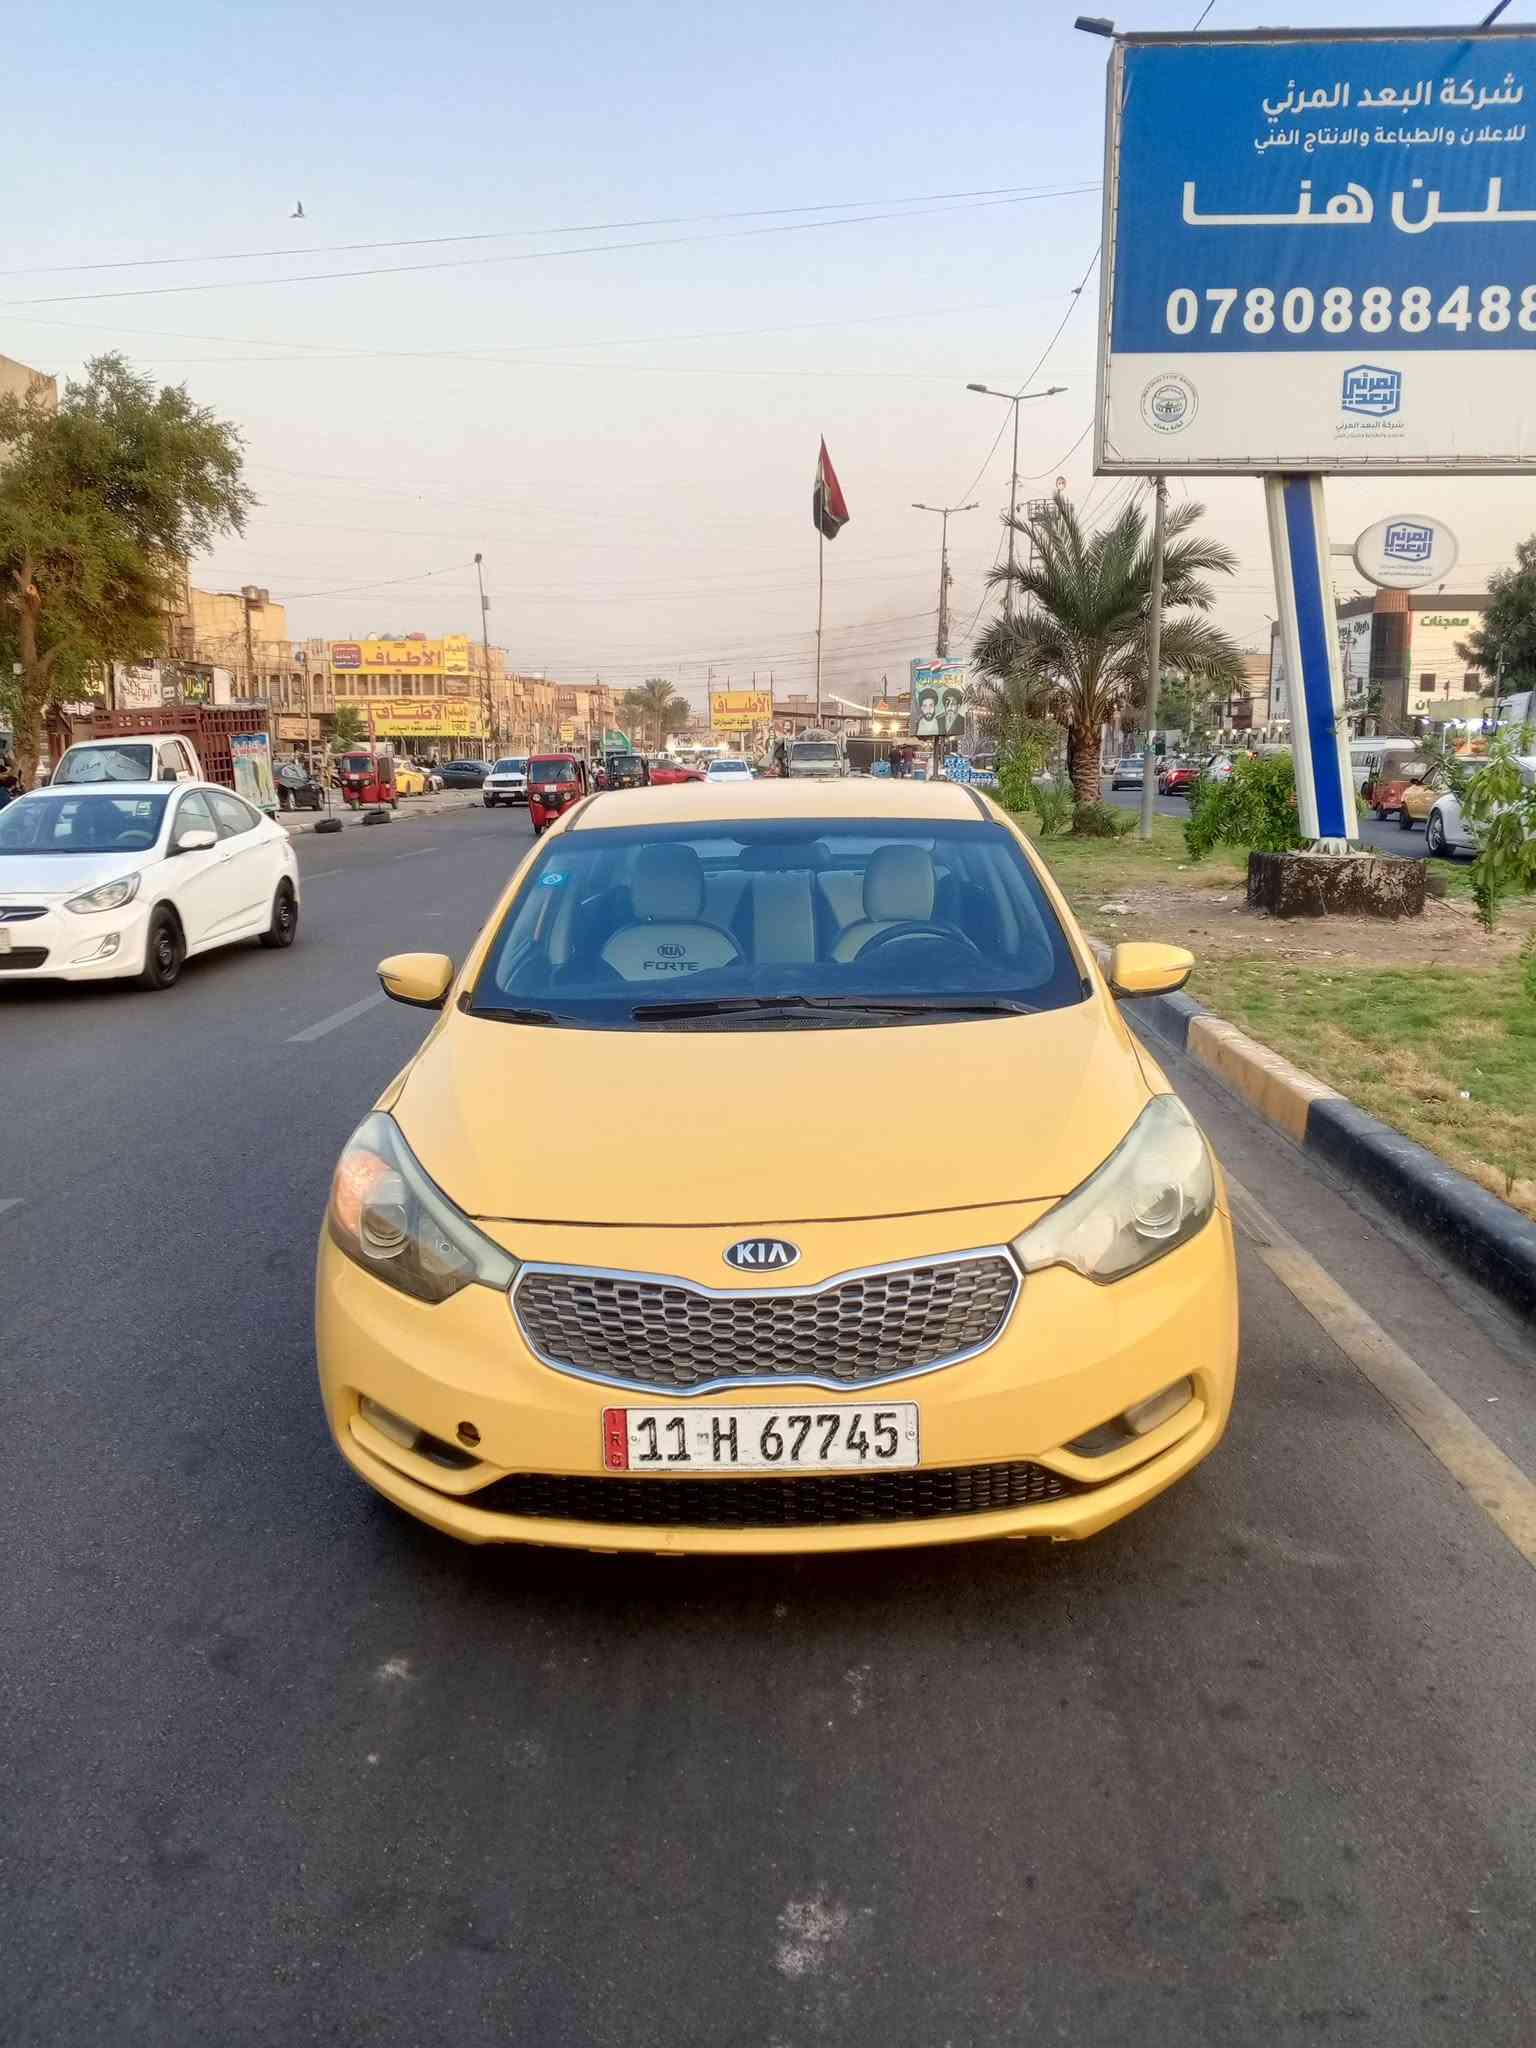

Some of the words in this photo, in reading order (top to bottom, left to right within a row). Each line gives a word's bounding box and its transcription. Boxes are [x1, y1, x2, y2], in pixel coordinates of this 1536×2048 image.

[1262, 79, 1349, 123] المرئي
[1357, 80, 1433, 114] البعد
[1440, 73, 1523, 110] شركة
[1254, 128, 1300, 154] الفني
[1303, 127, 1369, 152] والانتاج
[1374, 126, 1455, 148] والطباعة
[1460, 124, 1527, 145] للاعلان
[1183, 179, 1374, 225] هنا
[1391, 177, 1536, 234] لن
[1166, 285, 1536, 335] 0780888488
[1420, 615, 1470, 630] معجنات
[643, 961, 700, 972] FORTE
[736, 1243, 789, 1264] KIA
[637, 1416, 691, 1461] 11
[712, 1416, 738, 1462] H
[760, 1412, 898, 1462] 67745
